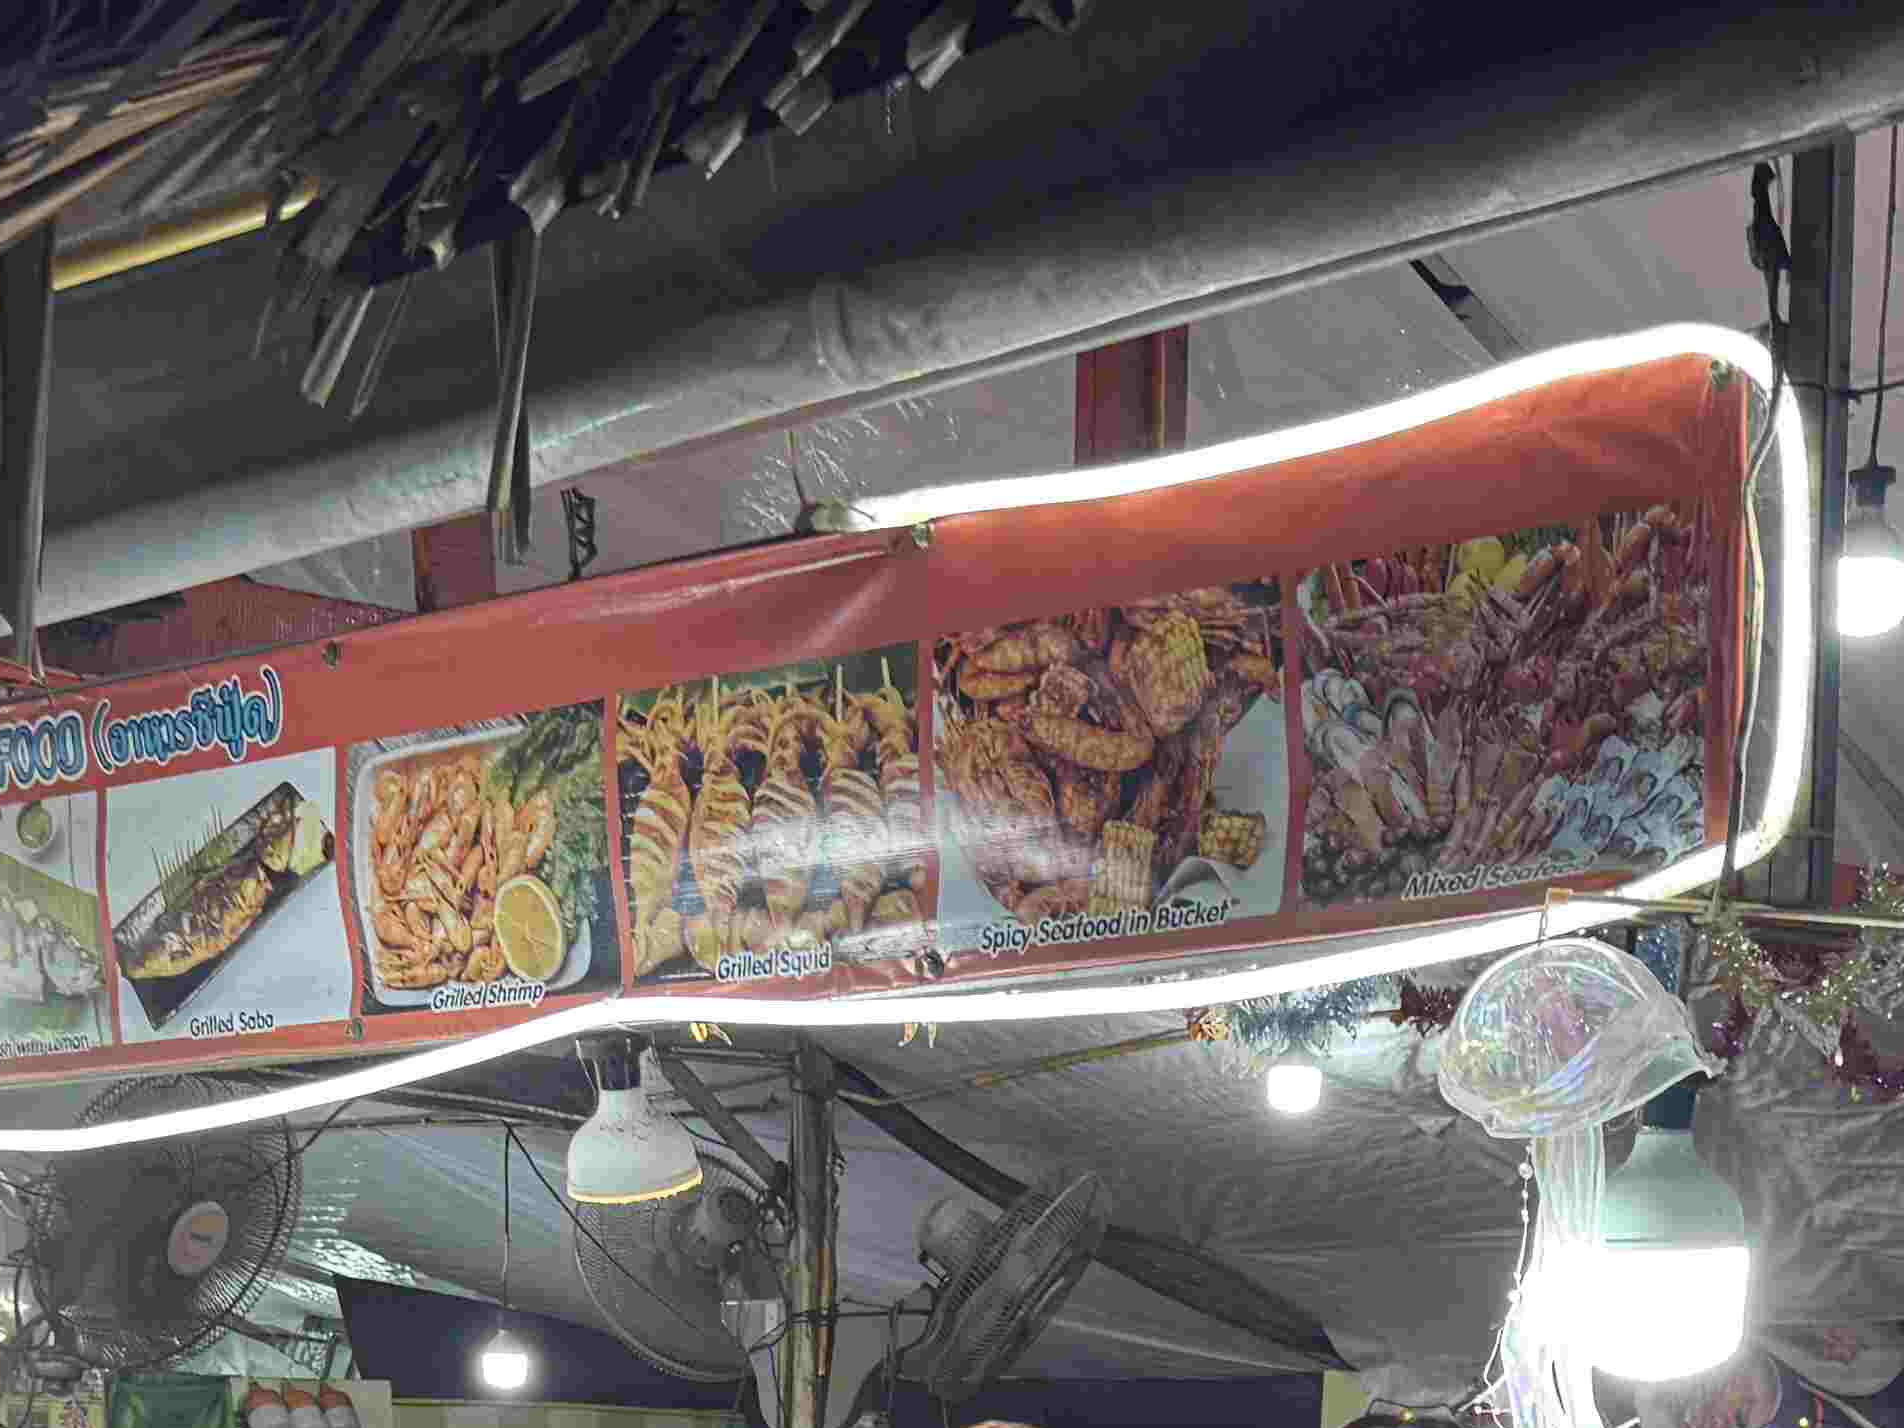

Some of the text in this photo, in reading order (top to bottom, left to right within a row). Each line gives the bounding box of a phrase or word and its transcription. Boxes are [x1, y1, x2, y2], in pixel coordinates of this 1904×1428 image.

[1405, 866, 1479, 899] Mixed
[981, 901, 1231, 953] Spicy Seafood in Bucket
[718, 944, 832, 980] Grilled Squid
[432, 981, 543, 1010] Grilled Shrimp
[190, 1010, 275, 1037] Grilled Saba
